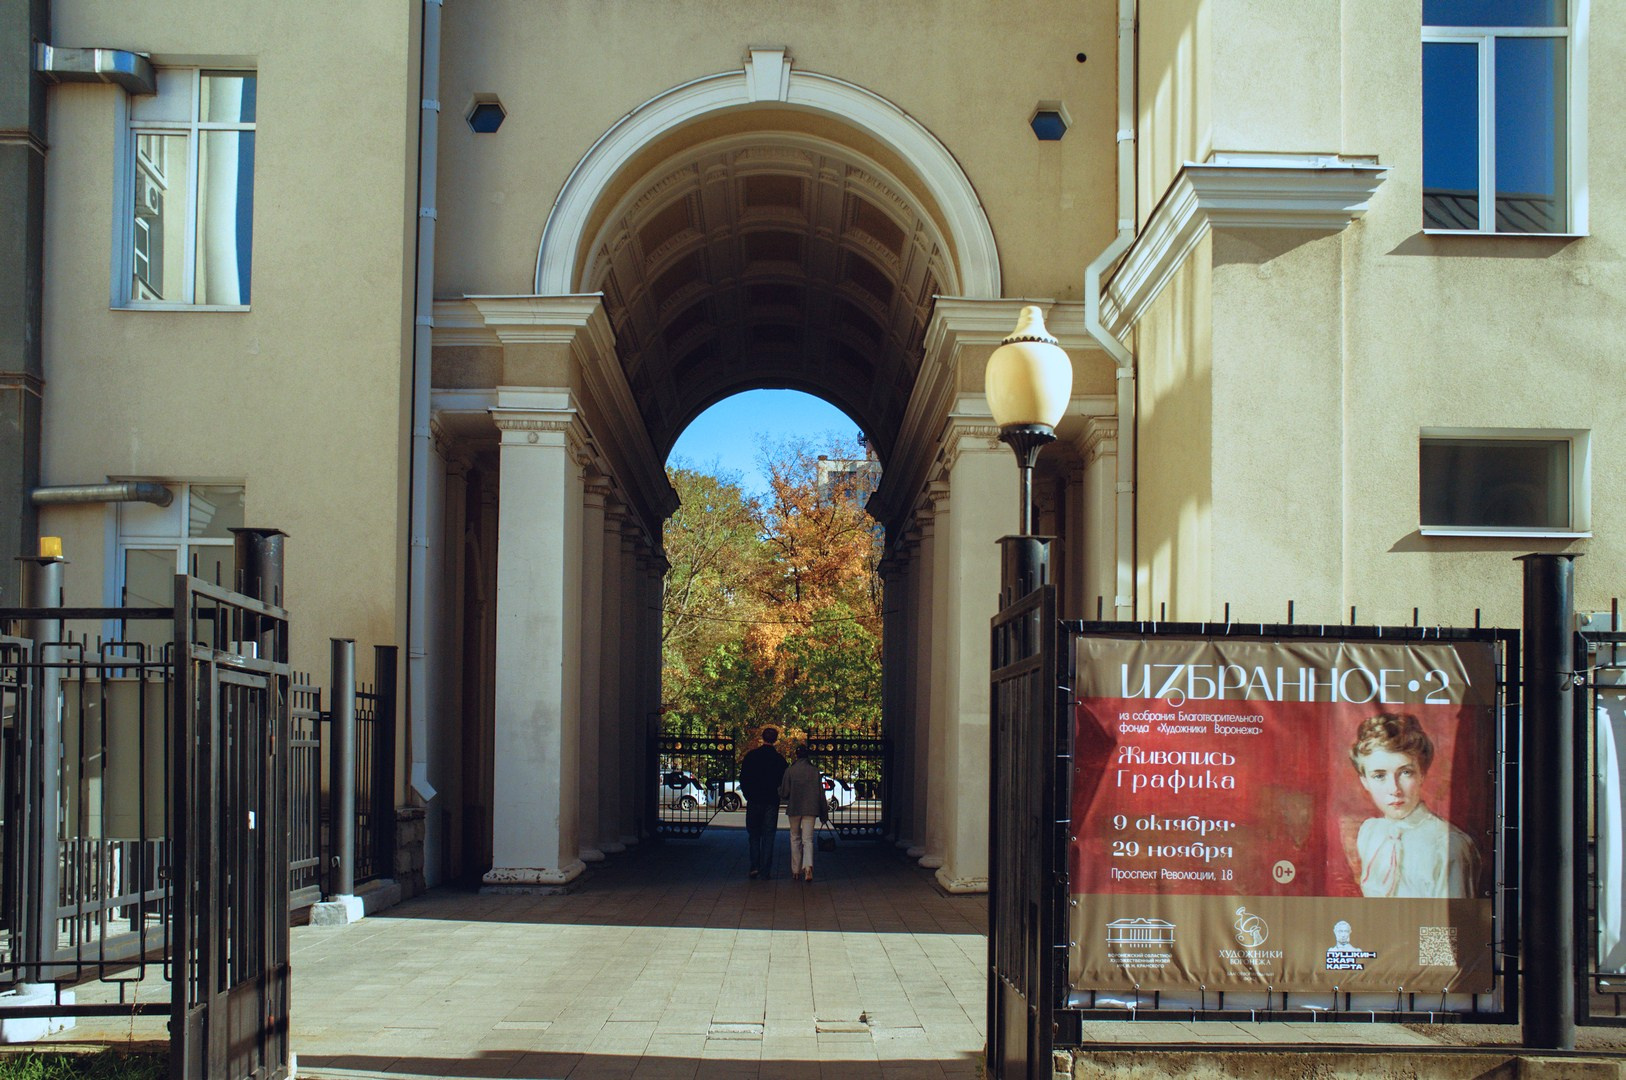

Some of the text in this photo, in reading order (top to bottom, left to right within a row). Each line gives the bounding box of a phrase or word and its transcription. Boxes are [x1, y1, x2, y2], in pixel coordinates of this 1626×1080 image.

[1119, 710, 1264, 723] из собрания Благотворительного
[1119, 722, 1263, 736] фонда «Художники Воронежа»
[1118, 745, 1235, 766] Живопись
[1117, 769, 1235, 794] Графика
[1113, 814, 1127, 831] 9
[1112, 840, 1233, 863] 29 ноября
[1111, 868, 1233, 881] Проспект Революции, 18
[1275, 865, 1293, 878] 0+
[1219, 950, 1283, 959] ХУДОЖНИКИ
